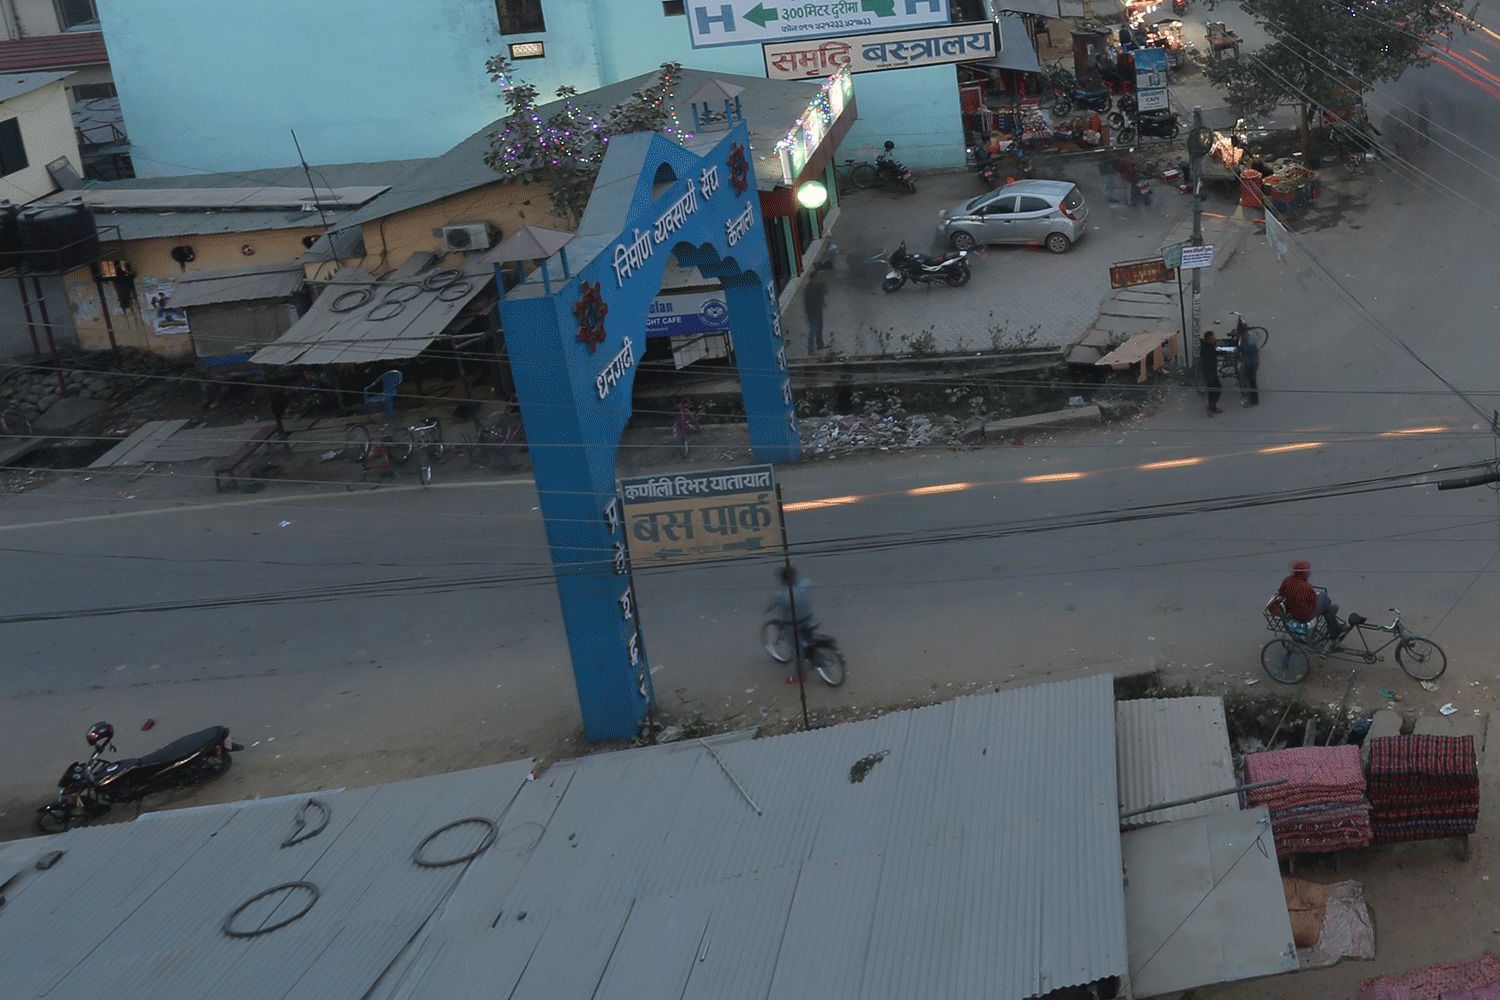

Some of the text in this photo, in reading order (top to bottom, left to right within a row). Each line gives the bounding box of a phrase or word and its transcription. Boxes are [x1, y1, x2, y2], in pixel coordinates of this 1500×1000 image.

[663, 316, 682, 324] CAFE
[709, 472, 770, 491] यातायात
[632, 494, 772, 542] बस पार्क
